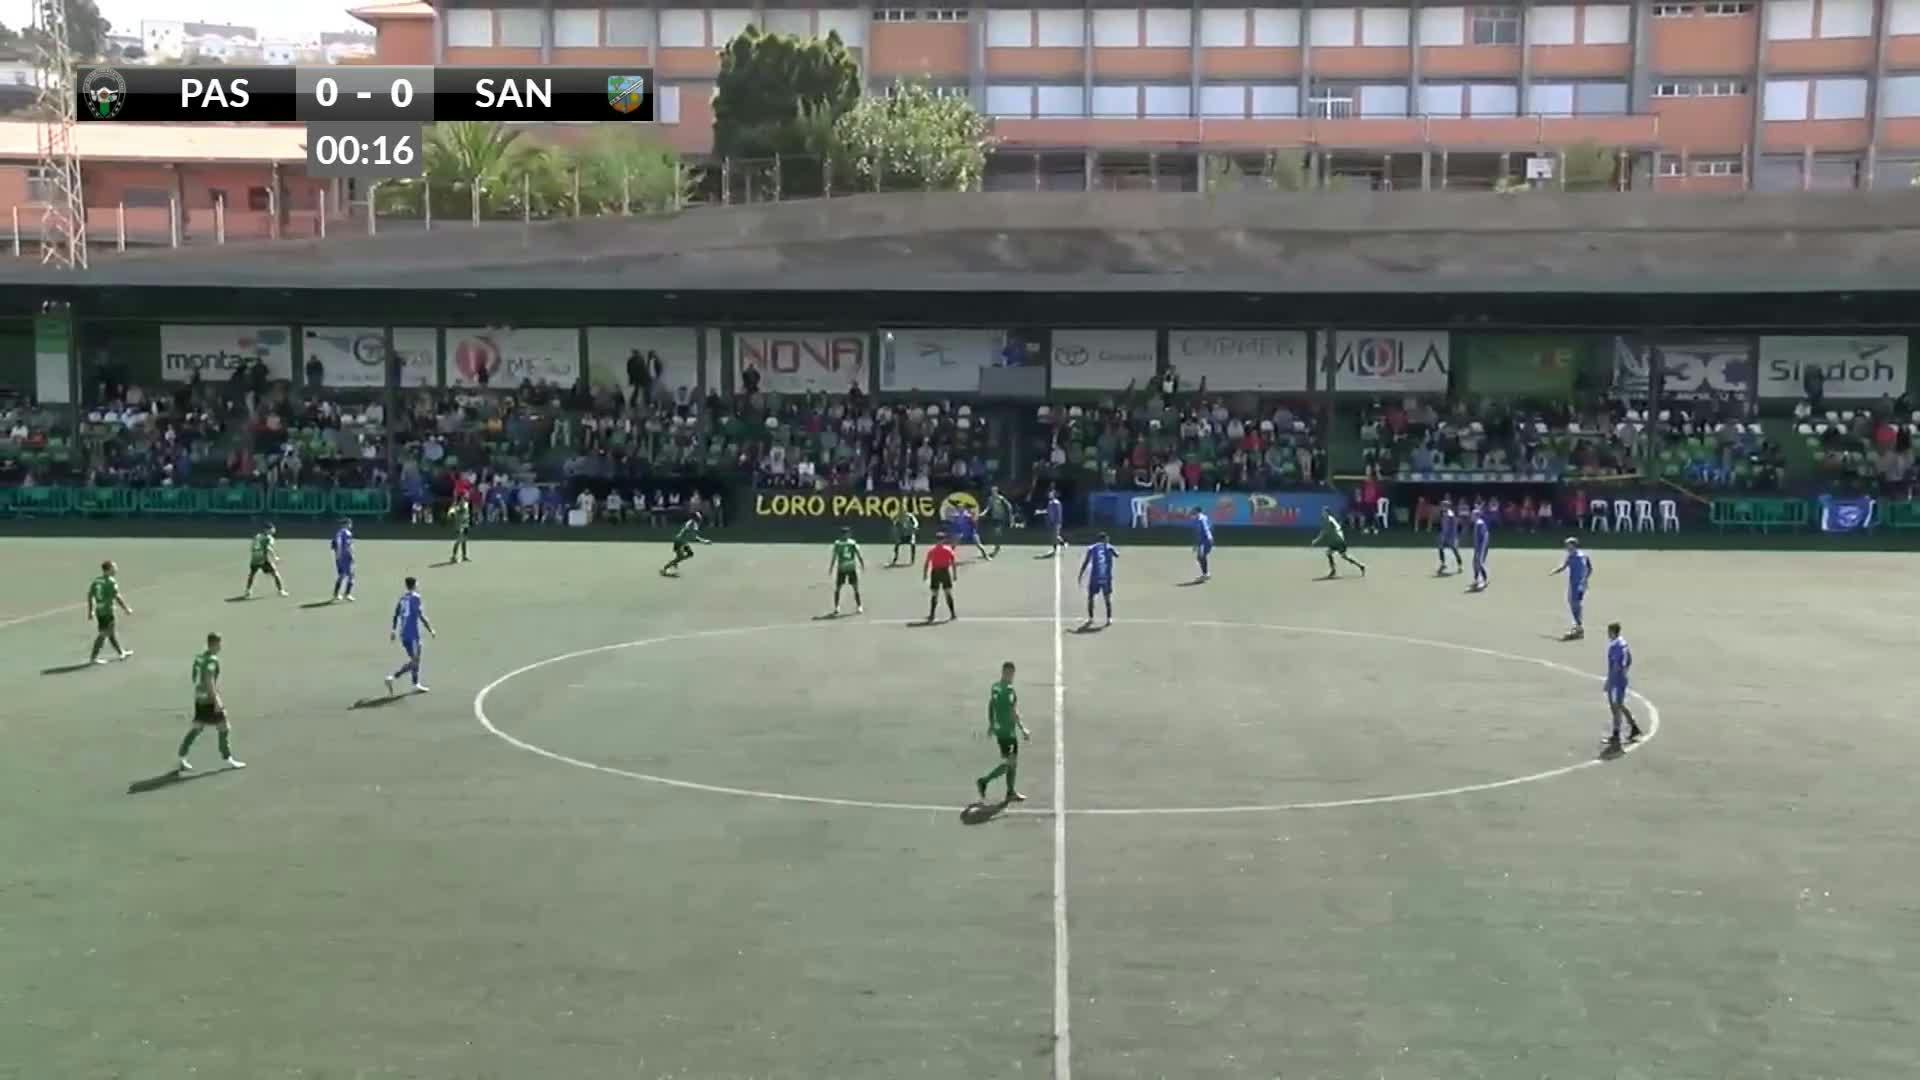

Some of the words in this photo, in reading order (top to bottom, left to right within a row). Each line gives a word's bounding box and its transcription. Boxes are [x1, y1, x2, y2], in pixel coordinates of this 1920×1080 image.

[739, 335, 863, 373] NOVA
[1320, 338, 1449, 376] MOLA
[755, 494, 825, 516] LORO
[832, 495, 936, 518] PARQUE
